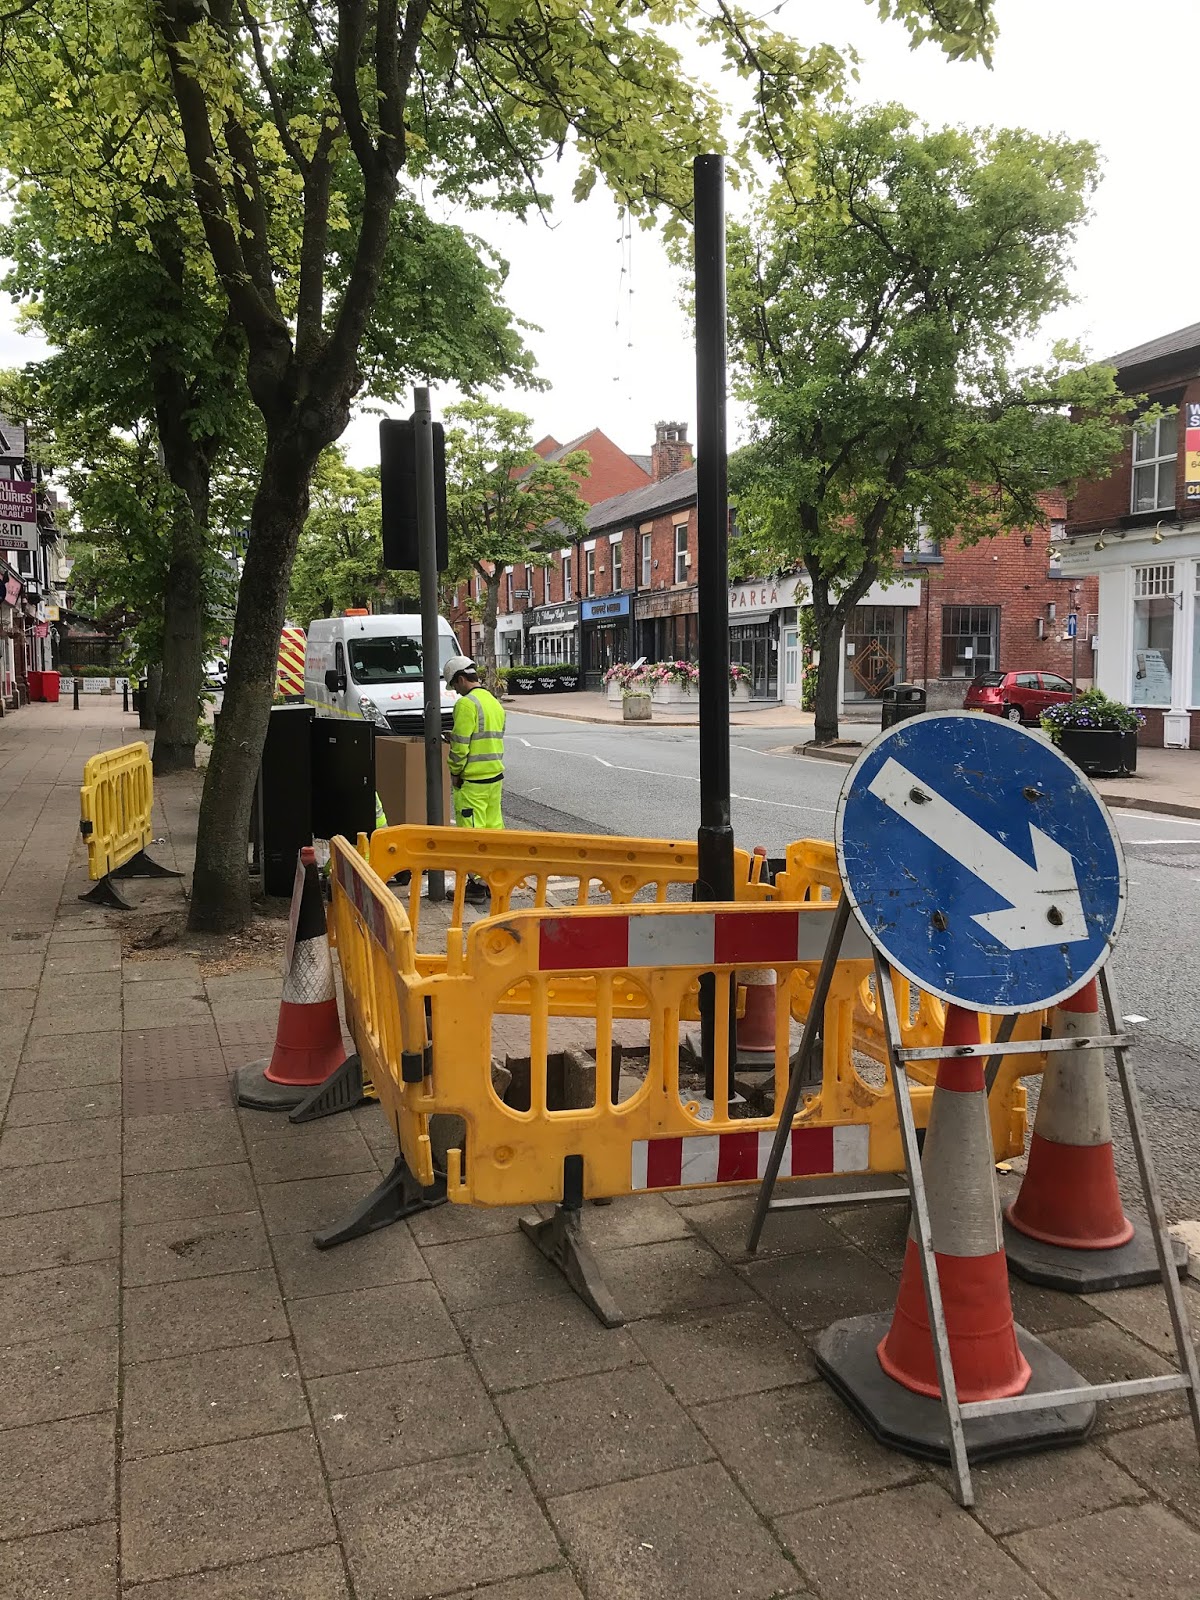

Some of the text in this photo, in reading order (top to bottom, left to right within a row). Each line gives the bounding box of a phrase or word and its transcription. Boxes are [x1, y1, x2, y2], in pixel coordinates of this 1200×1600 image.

[0, 491, 32, 504] UIRIES
[22, 505, 34, 513] LET
[731, 588, 778, 608] PAREA
